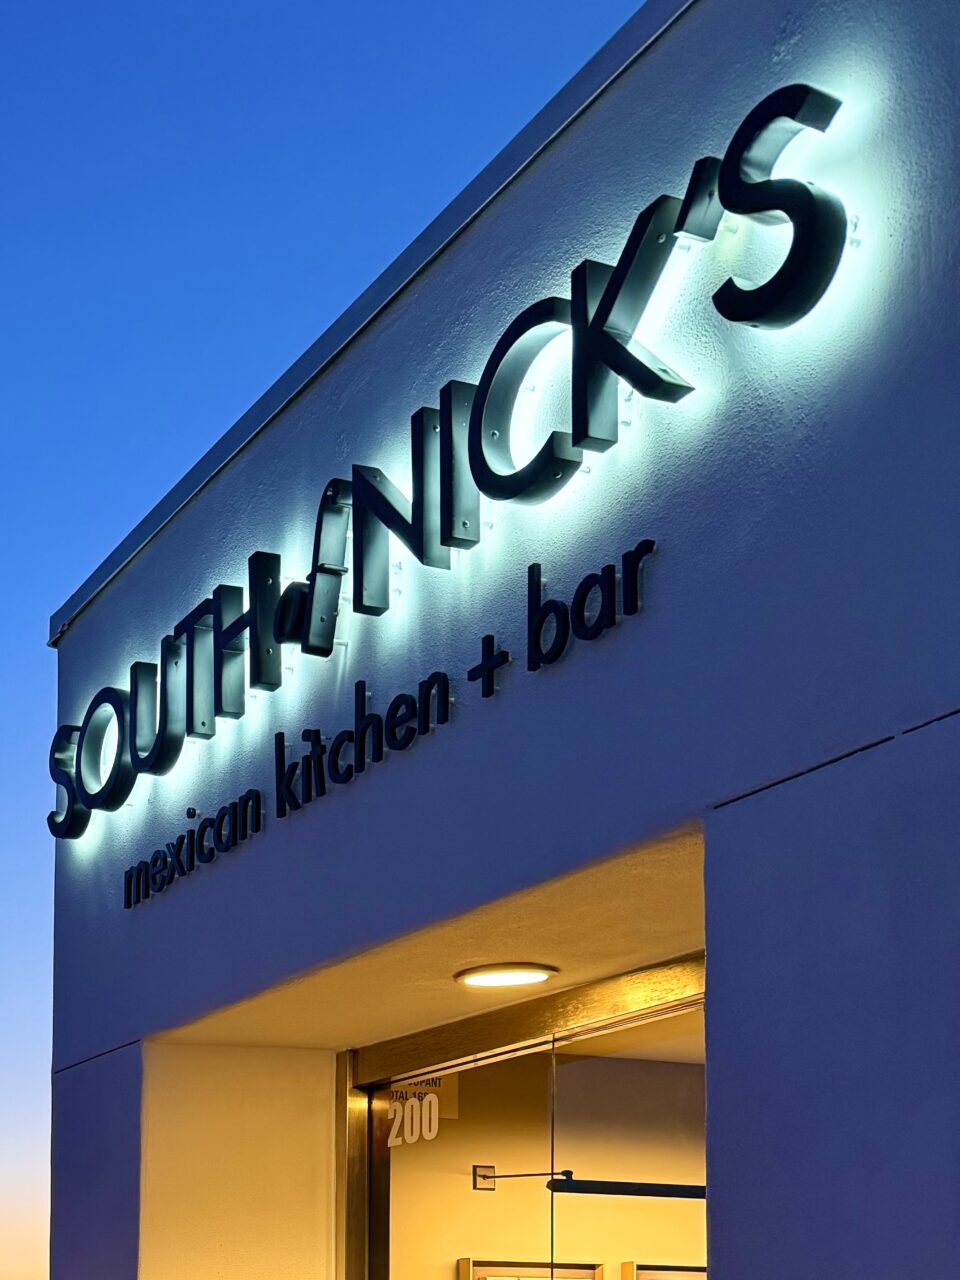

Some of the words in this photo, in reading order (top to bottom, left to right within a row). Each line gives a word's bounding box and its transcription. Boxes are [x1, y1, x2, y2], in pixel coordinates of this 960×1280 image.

[47, 551, 281, 839] SOUTH
[351, 83, 849, 617] NICK'S
[124, 788, 262, 910] mexican
[274, 670, 450, 819] kitchen
[527, 538, 656, 672] bar
[387, 1092, 439, 1148] 200
